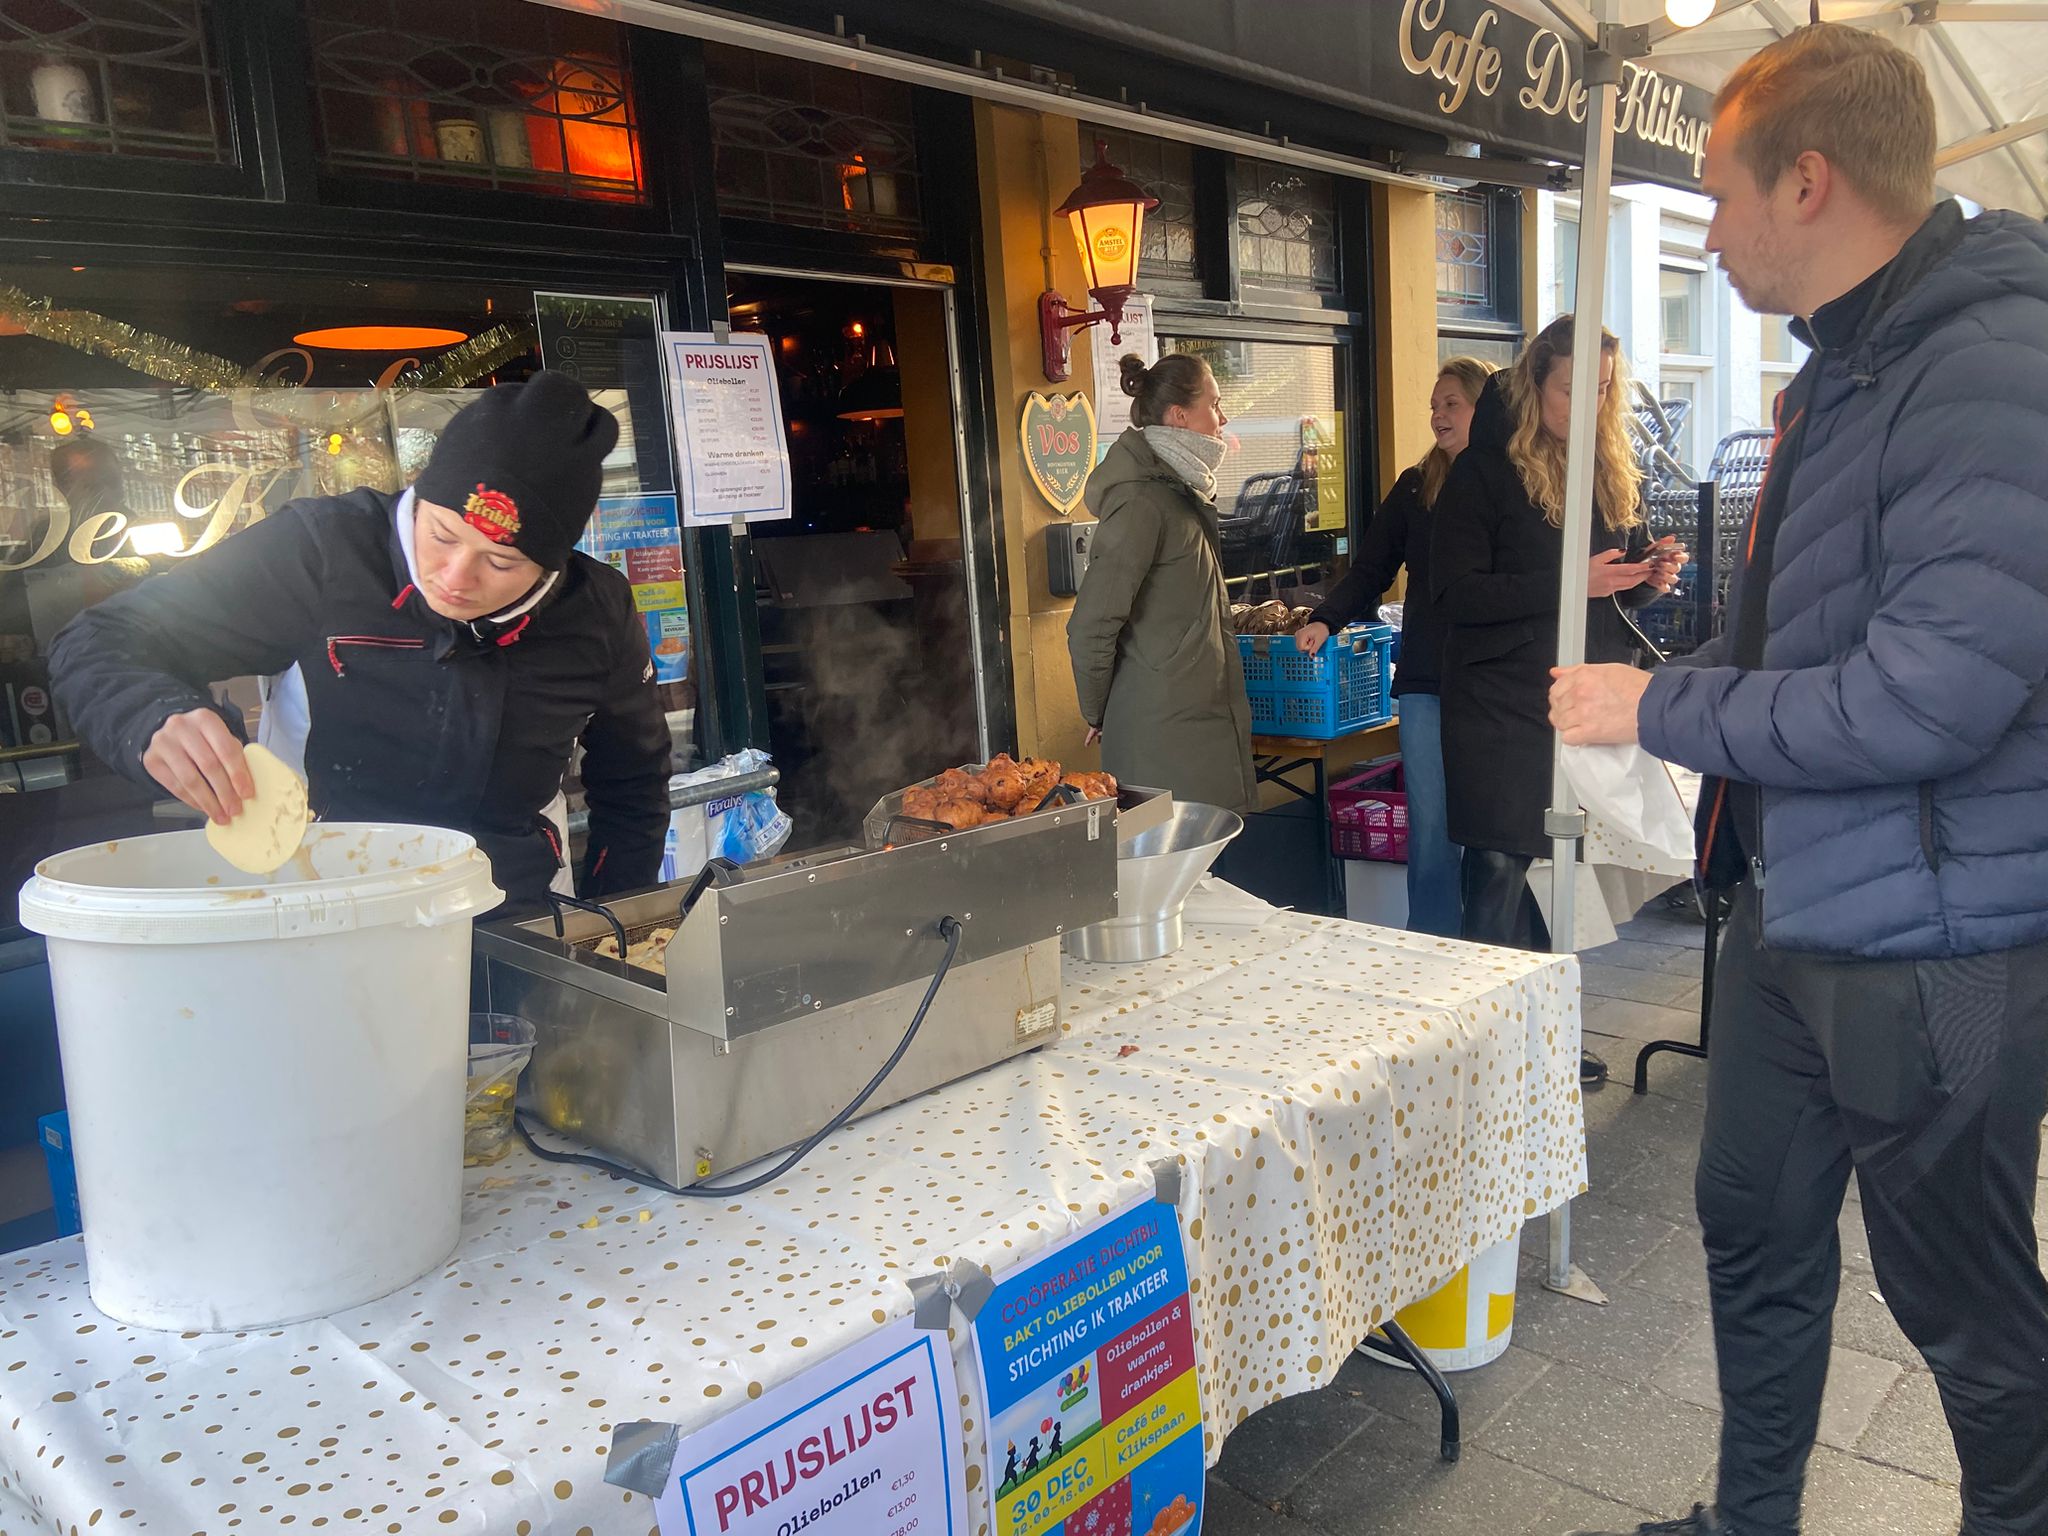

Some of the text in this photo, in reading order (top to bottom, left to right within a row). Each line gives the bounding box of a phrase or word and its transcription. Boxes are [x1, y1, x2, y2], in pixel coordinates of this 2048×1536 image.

[1519, 27, 1588, 123] De
[1100, 238, 1123, 246] AMSTEL
[685, 354, 759, 369] PRIJSLIJST
[708, 451, 734, 459] Warme
[623, 530, 632, 540] IK
[632, 527, 670, 540] TRAKTEER
[709, 795, 743, 817] Floralys
[1002, 1218, 1159, 1324] COÖPERATIE DICHTBIJ
[1004, 1245, 1164, 1352] BAKT OLIEBOLLEN VOOR
[1009, 1267, 1169, 1382] STICHTING IK TRAKTEER
[1106, 1306, 1182, 1363] Oliebollen &
[1120, 1355, 1174, 1399] drankjes!
[1127, 1340, 1166, 1372] warme
[1116, 1403, 1167, 1444] Café de
[1117, 1411, 1186, 1466] Klikspaan
[714, 1375, 917, 1533] PRIJSLIJST
[776, 1467, 882, 1536] Oliebollen
[891, 1470, 915, 1491] €1,30
[1011, 1457, 1088, 1524] 30 DEC
[887, 1493, 917, 1518] €13,00
